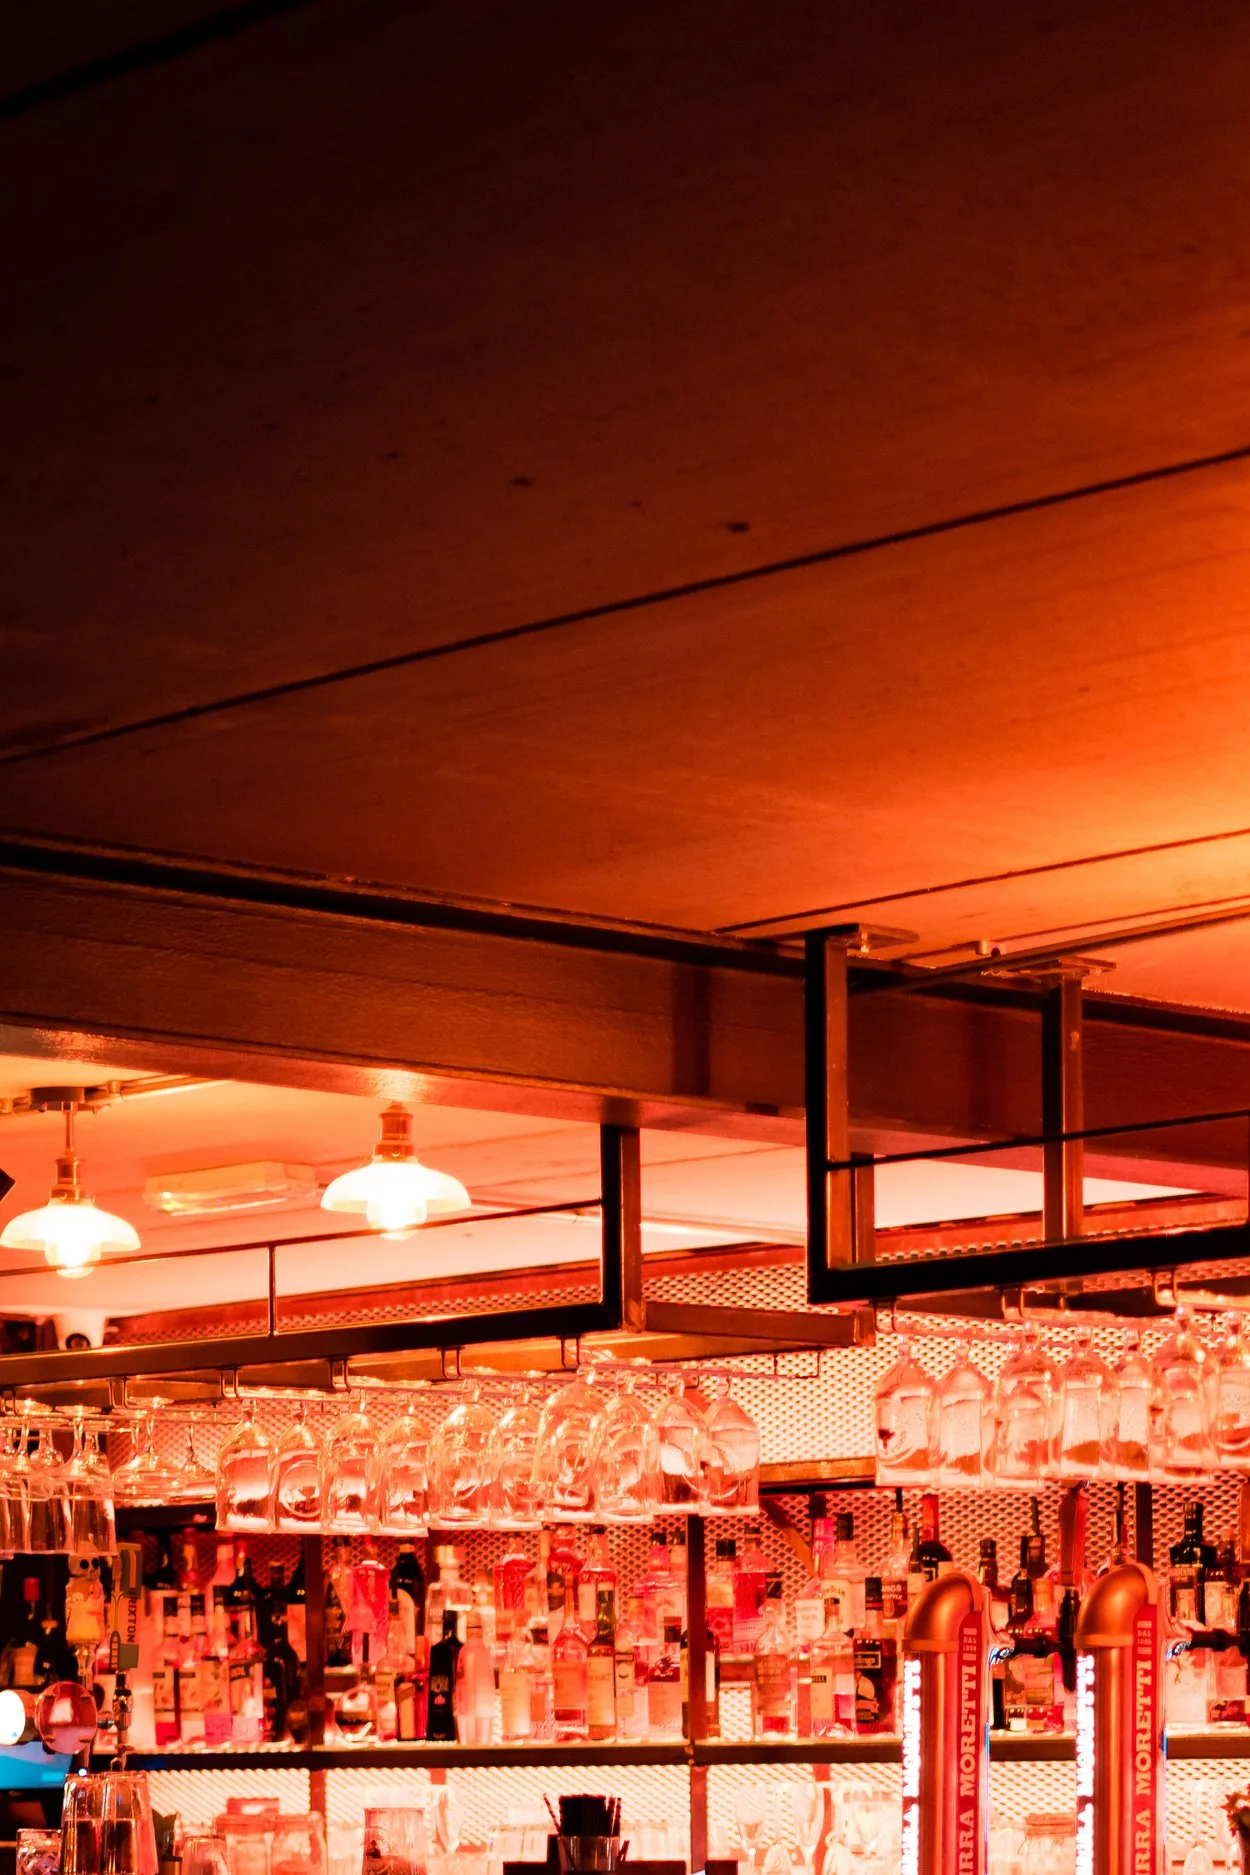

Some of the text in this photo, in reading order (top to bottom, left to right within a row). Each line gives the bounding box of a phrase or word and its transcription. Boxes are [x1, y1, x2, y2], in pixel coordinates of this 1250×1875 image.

[963, 1636, 977, 1644] DAL
[960, 1665, 977, 1797] MORETTI
[1136, 1660, 1152, 1796] MORETTI
